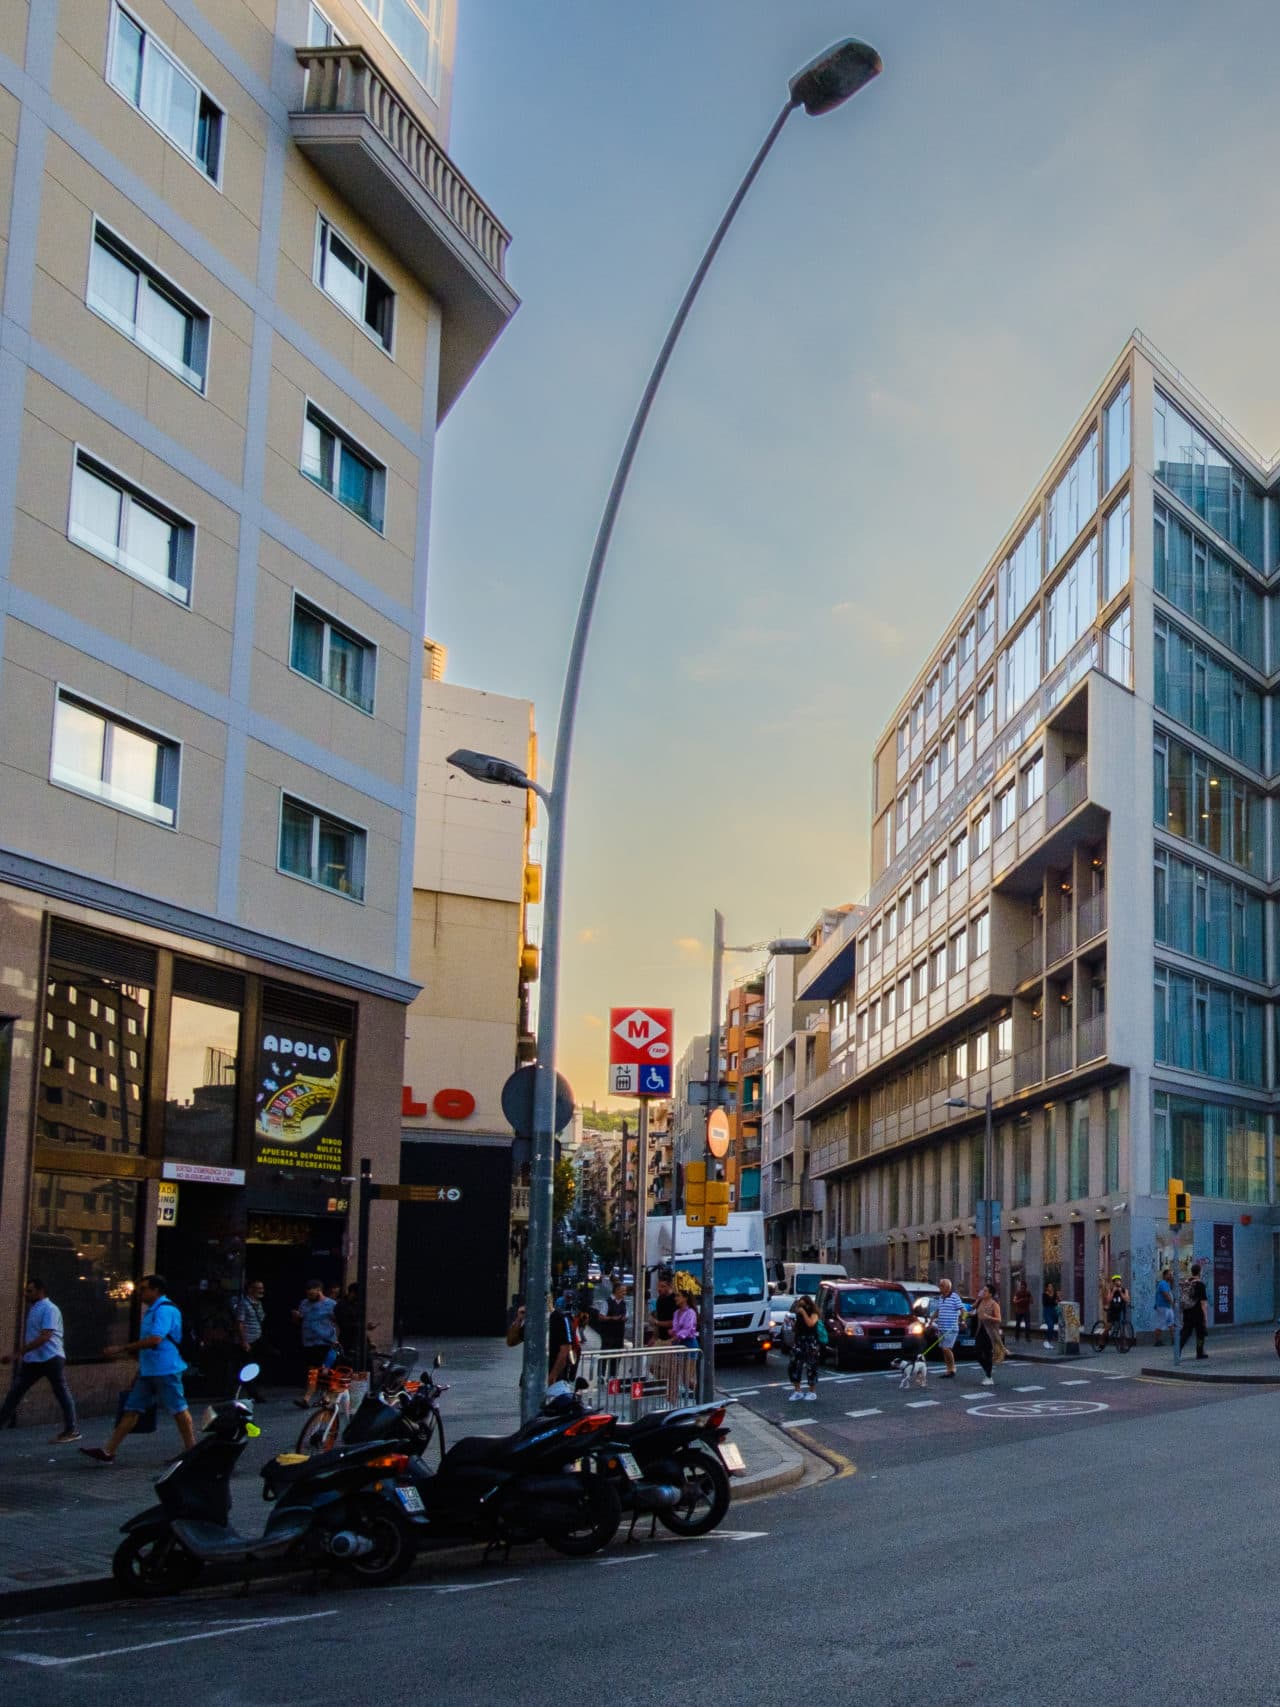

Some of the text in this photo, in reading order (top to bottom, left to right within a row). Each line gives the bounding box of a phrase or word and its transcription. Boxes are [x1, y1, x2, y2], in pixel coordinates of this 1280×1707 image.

[628, 1021, 649, 1038] M
[263, 1034, 331, 1062] APOLO
[261, 1147, 342, 1162] APUESTAS DEPORTIVAS
[316, 1145, 342, 1154] RULETA
[256, 1155, 342, 1171] MÁQUINAS RECREATIVAS
[159, 1185, 177, 1194] ADA
